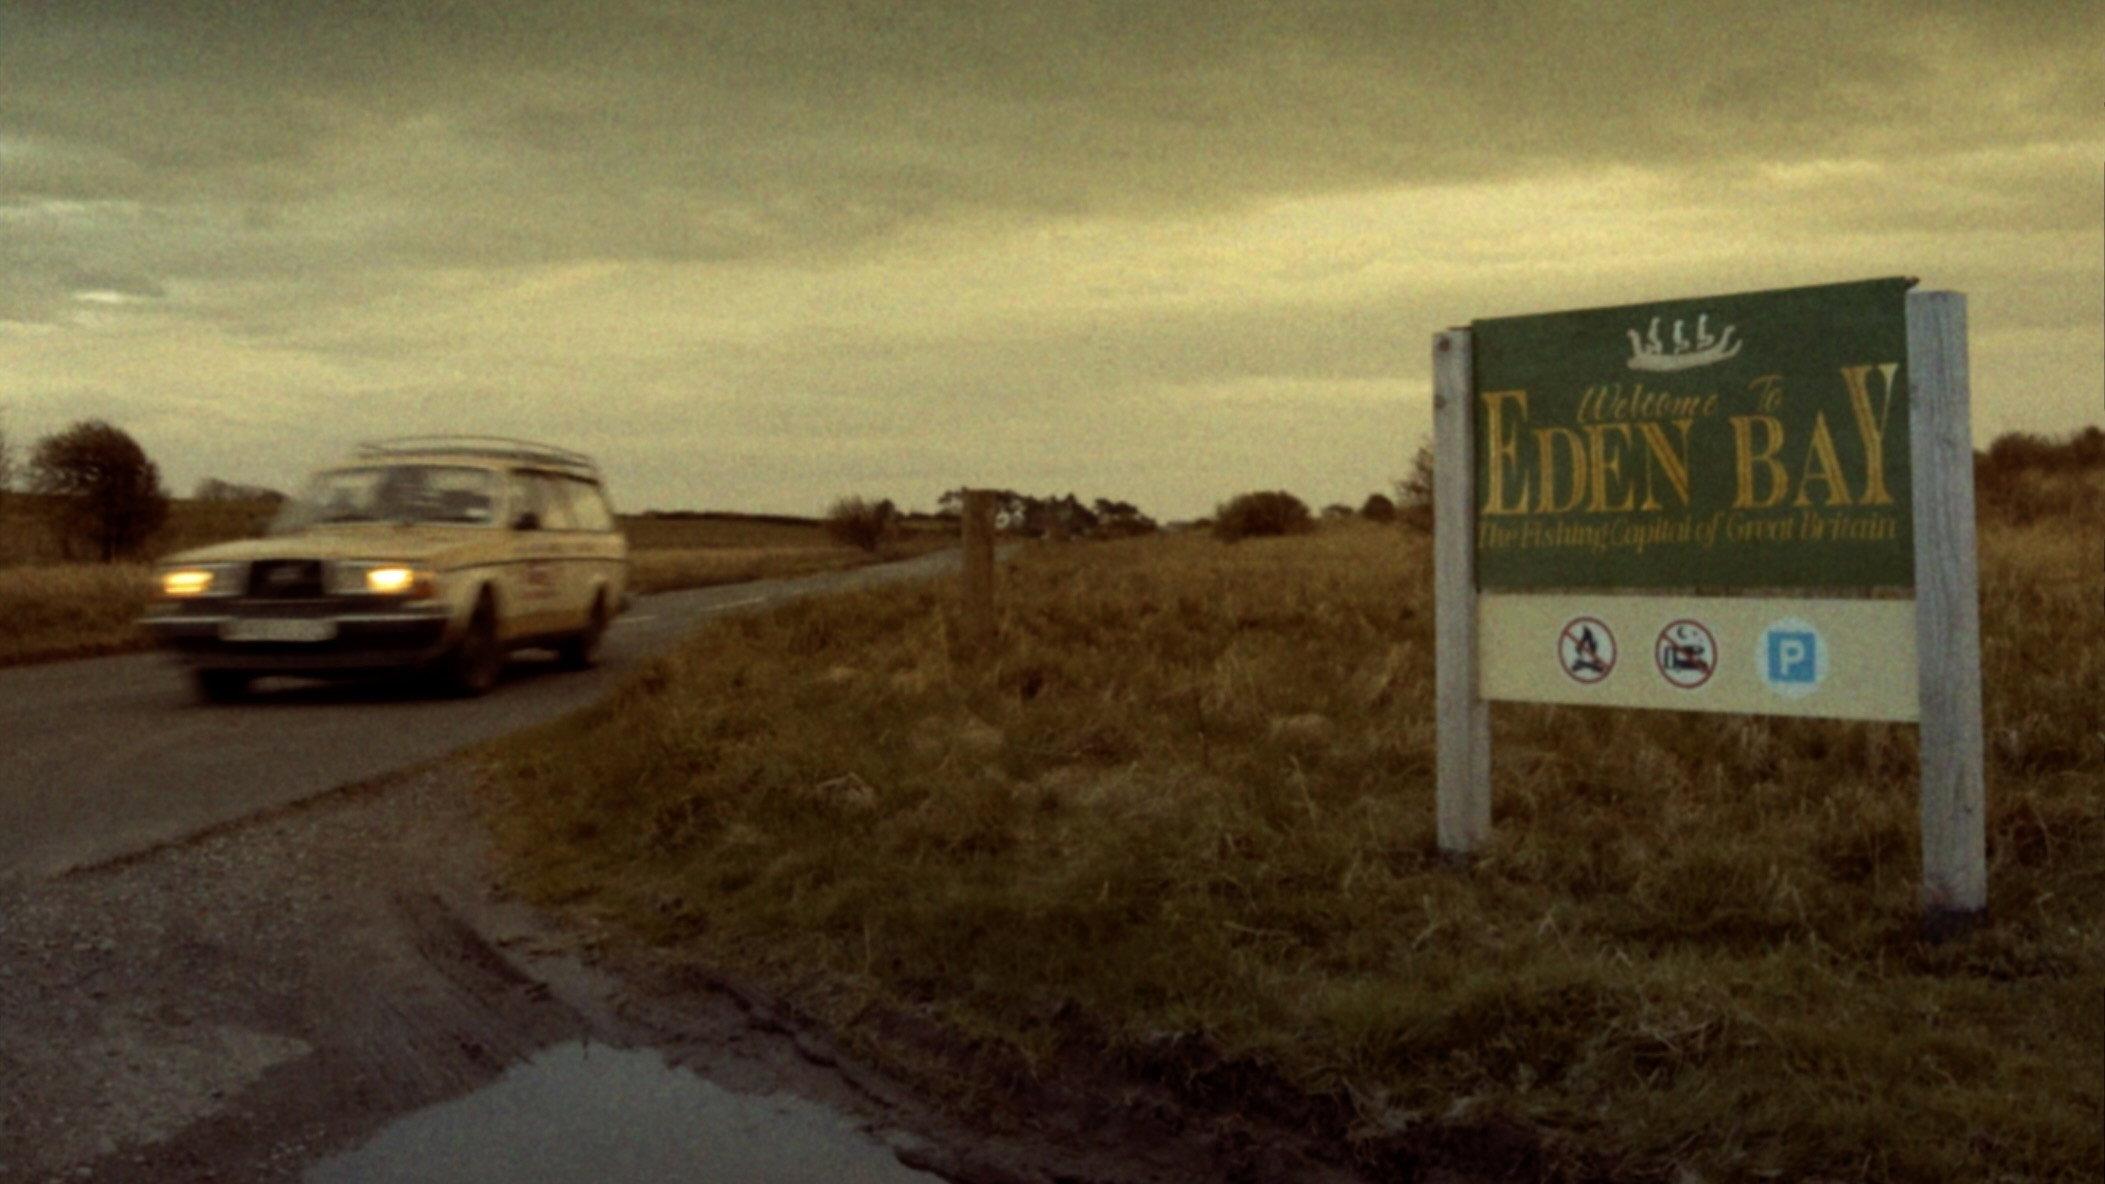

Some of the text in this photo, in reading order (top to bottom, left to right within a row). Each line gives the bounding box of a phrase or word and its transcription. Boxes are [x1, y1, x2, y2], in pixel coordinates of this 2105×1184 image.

[1577, 374, 1787, 423] Welcome To
[1481, 362, 1898, 516] EDEN BAY
[1521, 518, 1607, 552] Fishing
[1608, 515, 1692, 555] Capital
[1696, 511, 1724, 551] of
[1726, 511, 1794, 541] Great
[1800, 511, 1897, 541] Britain
[1780, 639, 1804, 675] P
